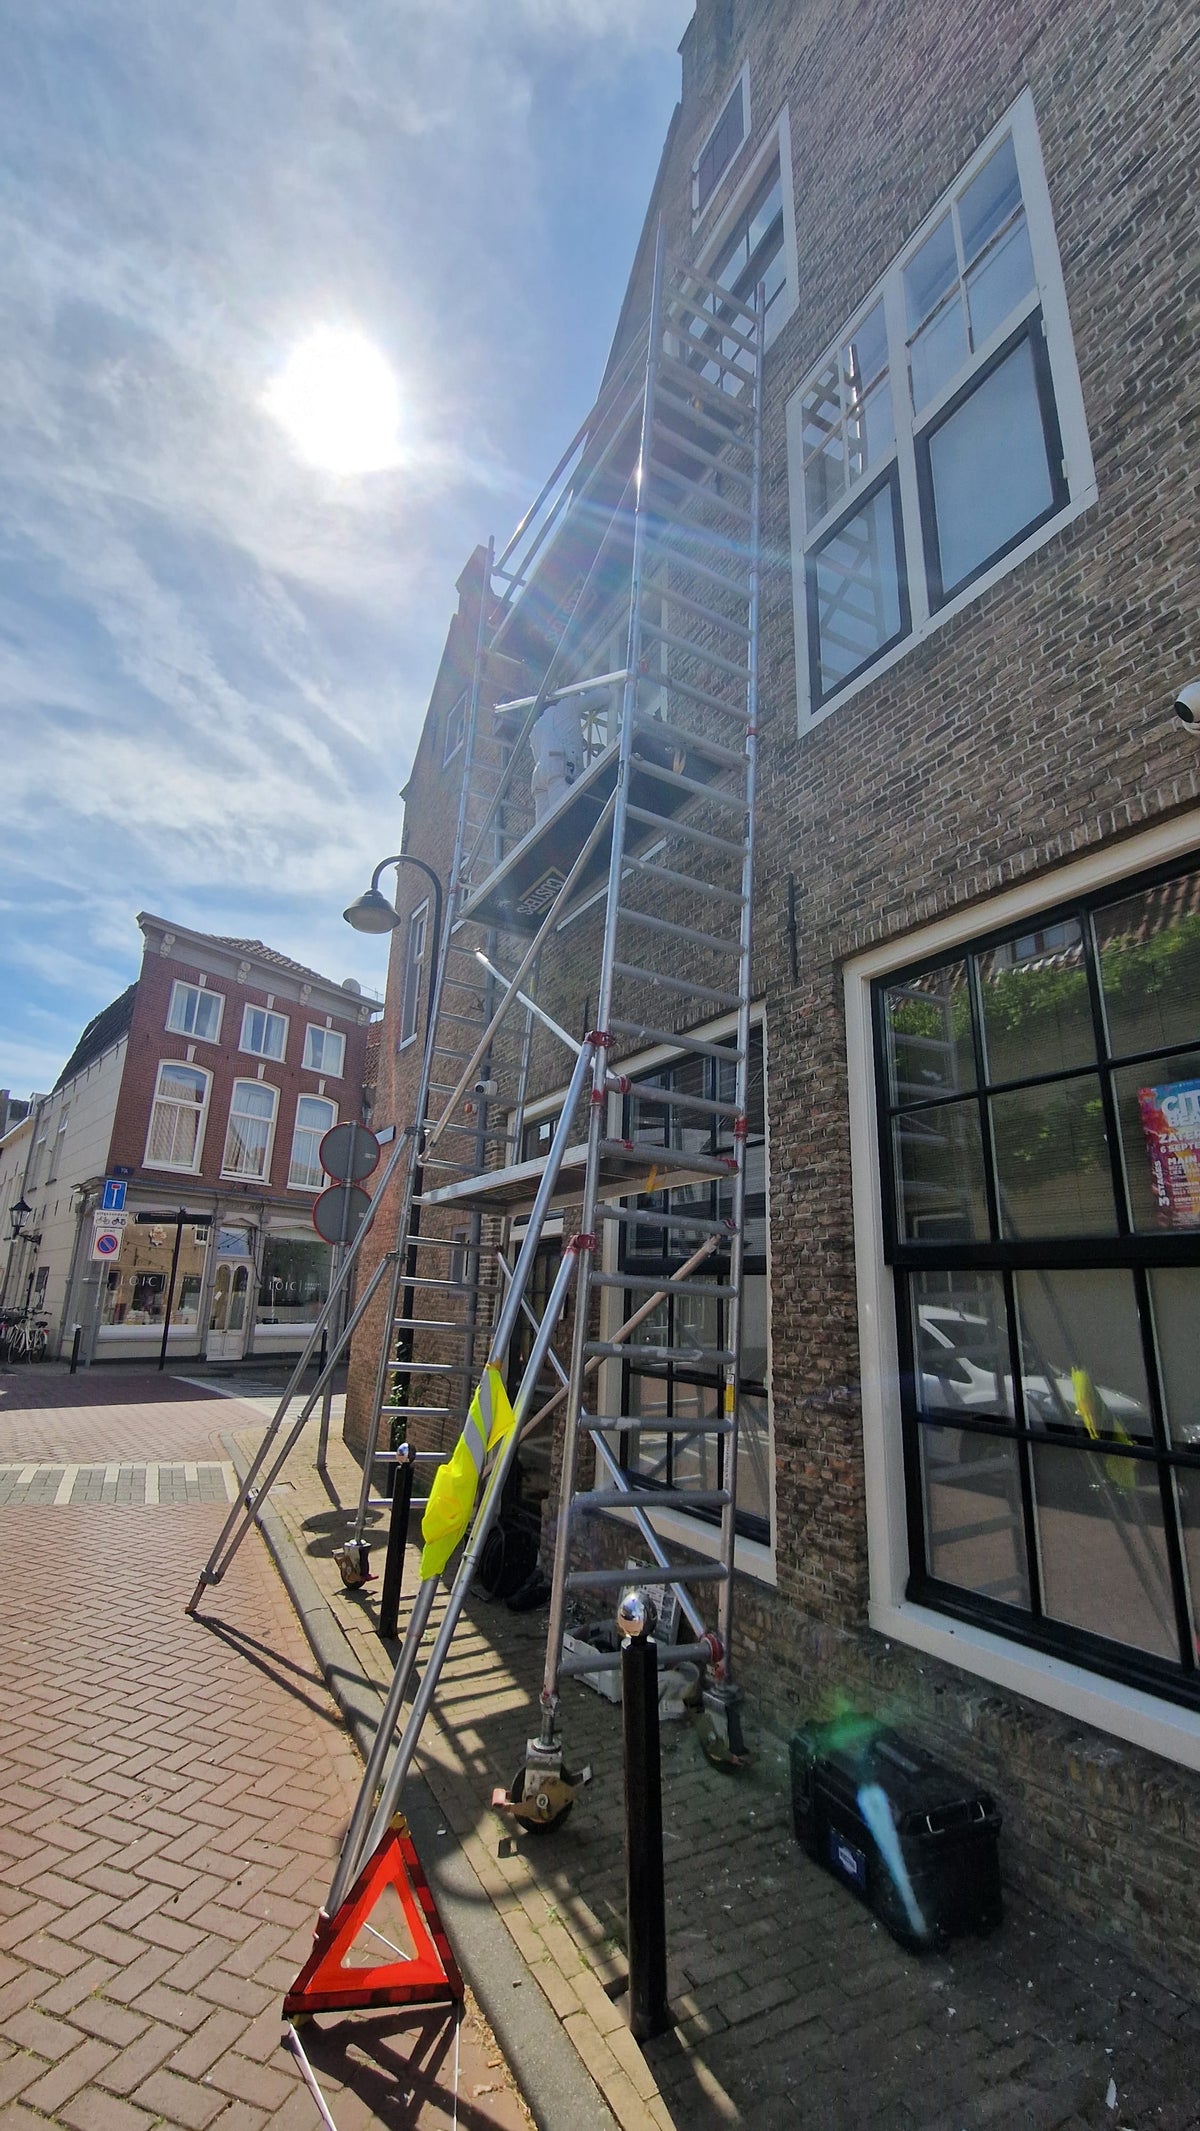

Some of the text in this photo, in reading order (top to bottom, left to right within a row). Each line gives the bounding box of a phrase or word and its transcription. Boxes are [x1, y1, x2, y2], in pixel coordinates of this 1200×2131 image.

[516, 878, 564, 915] CUSTERS
[1160, 1145, 1167, 1153] 6
[1167, 1155, 1197, 1166] MAIN
[1154, 1160, 1170, 1206] 3 STAGES
